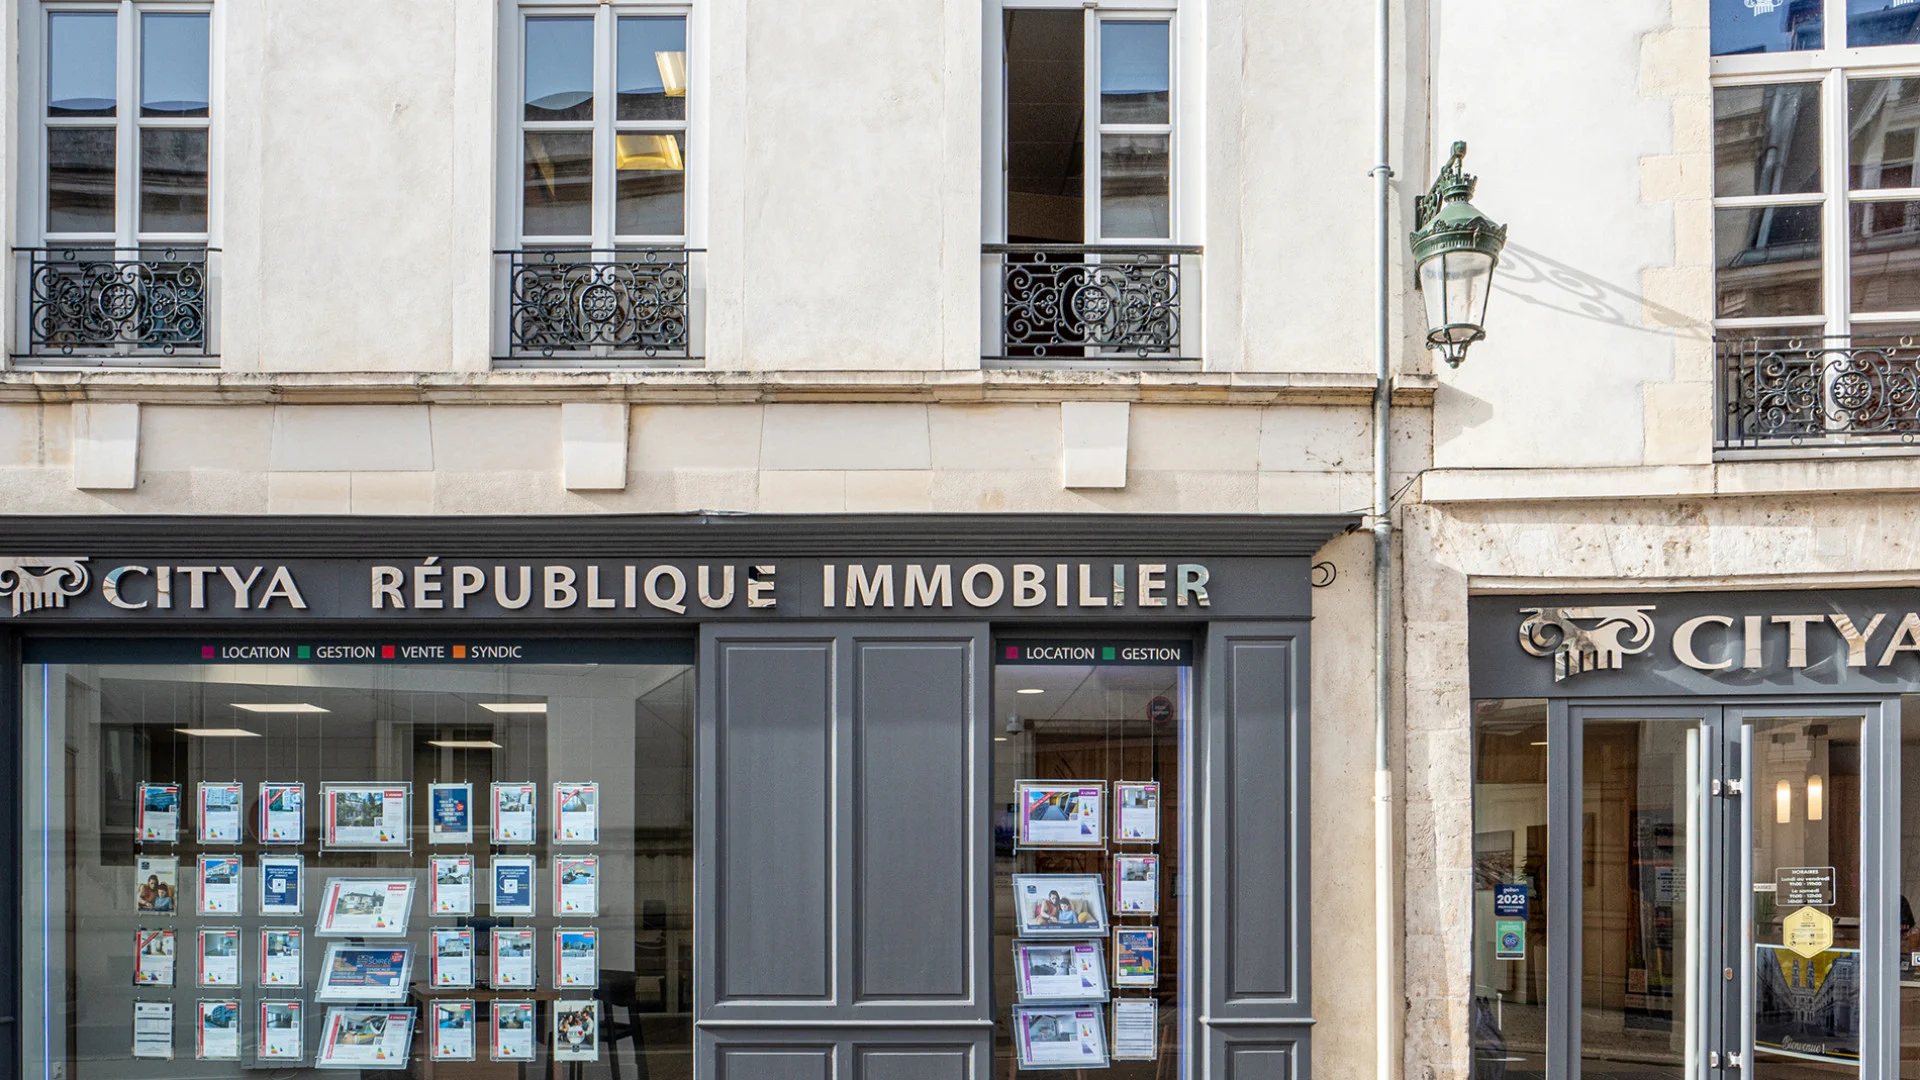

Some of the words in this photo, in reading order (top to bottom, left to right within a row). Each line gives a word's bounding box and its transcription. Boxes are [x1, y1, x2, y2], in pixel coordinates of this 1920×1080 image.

[102, 565, 309, 609] CITYA
[371, 556, 777, 615] RÉPUBLIQUE
[823, 563, 1212, 608] IMMOBILIER
[1672, 612, 1920, 670] CITYA
[222, 646, 290, 659] LOCATION
[316, 646, 375, 659] GESTION
[401, 646, 445, 659] VENTE
[471, 646, 522, 659] SYNDIC
[1026, 647, 1095, 660] LOCATION
[1121, 647, 1181, 661] GESTION
[1497, 894, 1525, 904] 2023
[1781, 1035, 1821, 1054] Bienvenue
